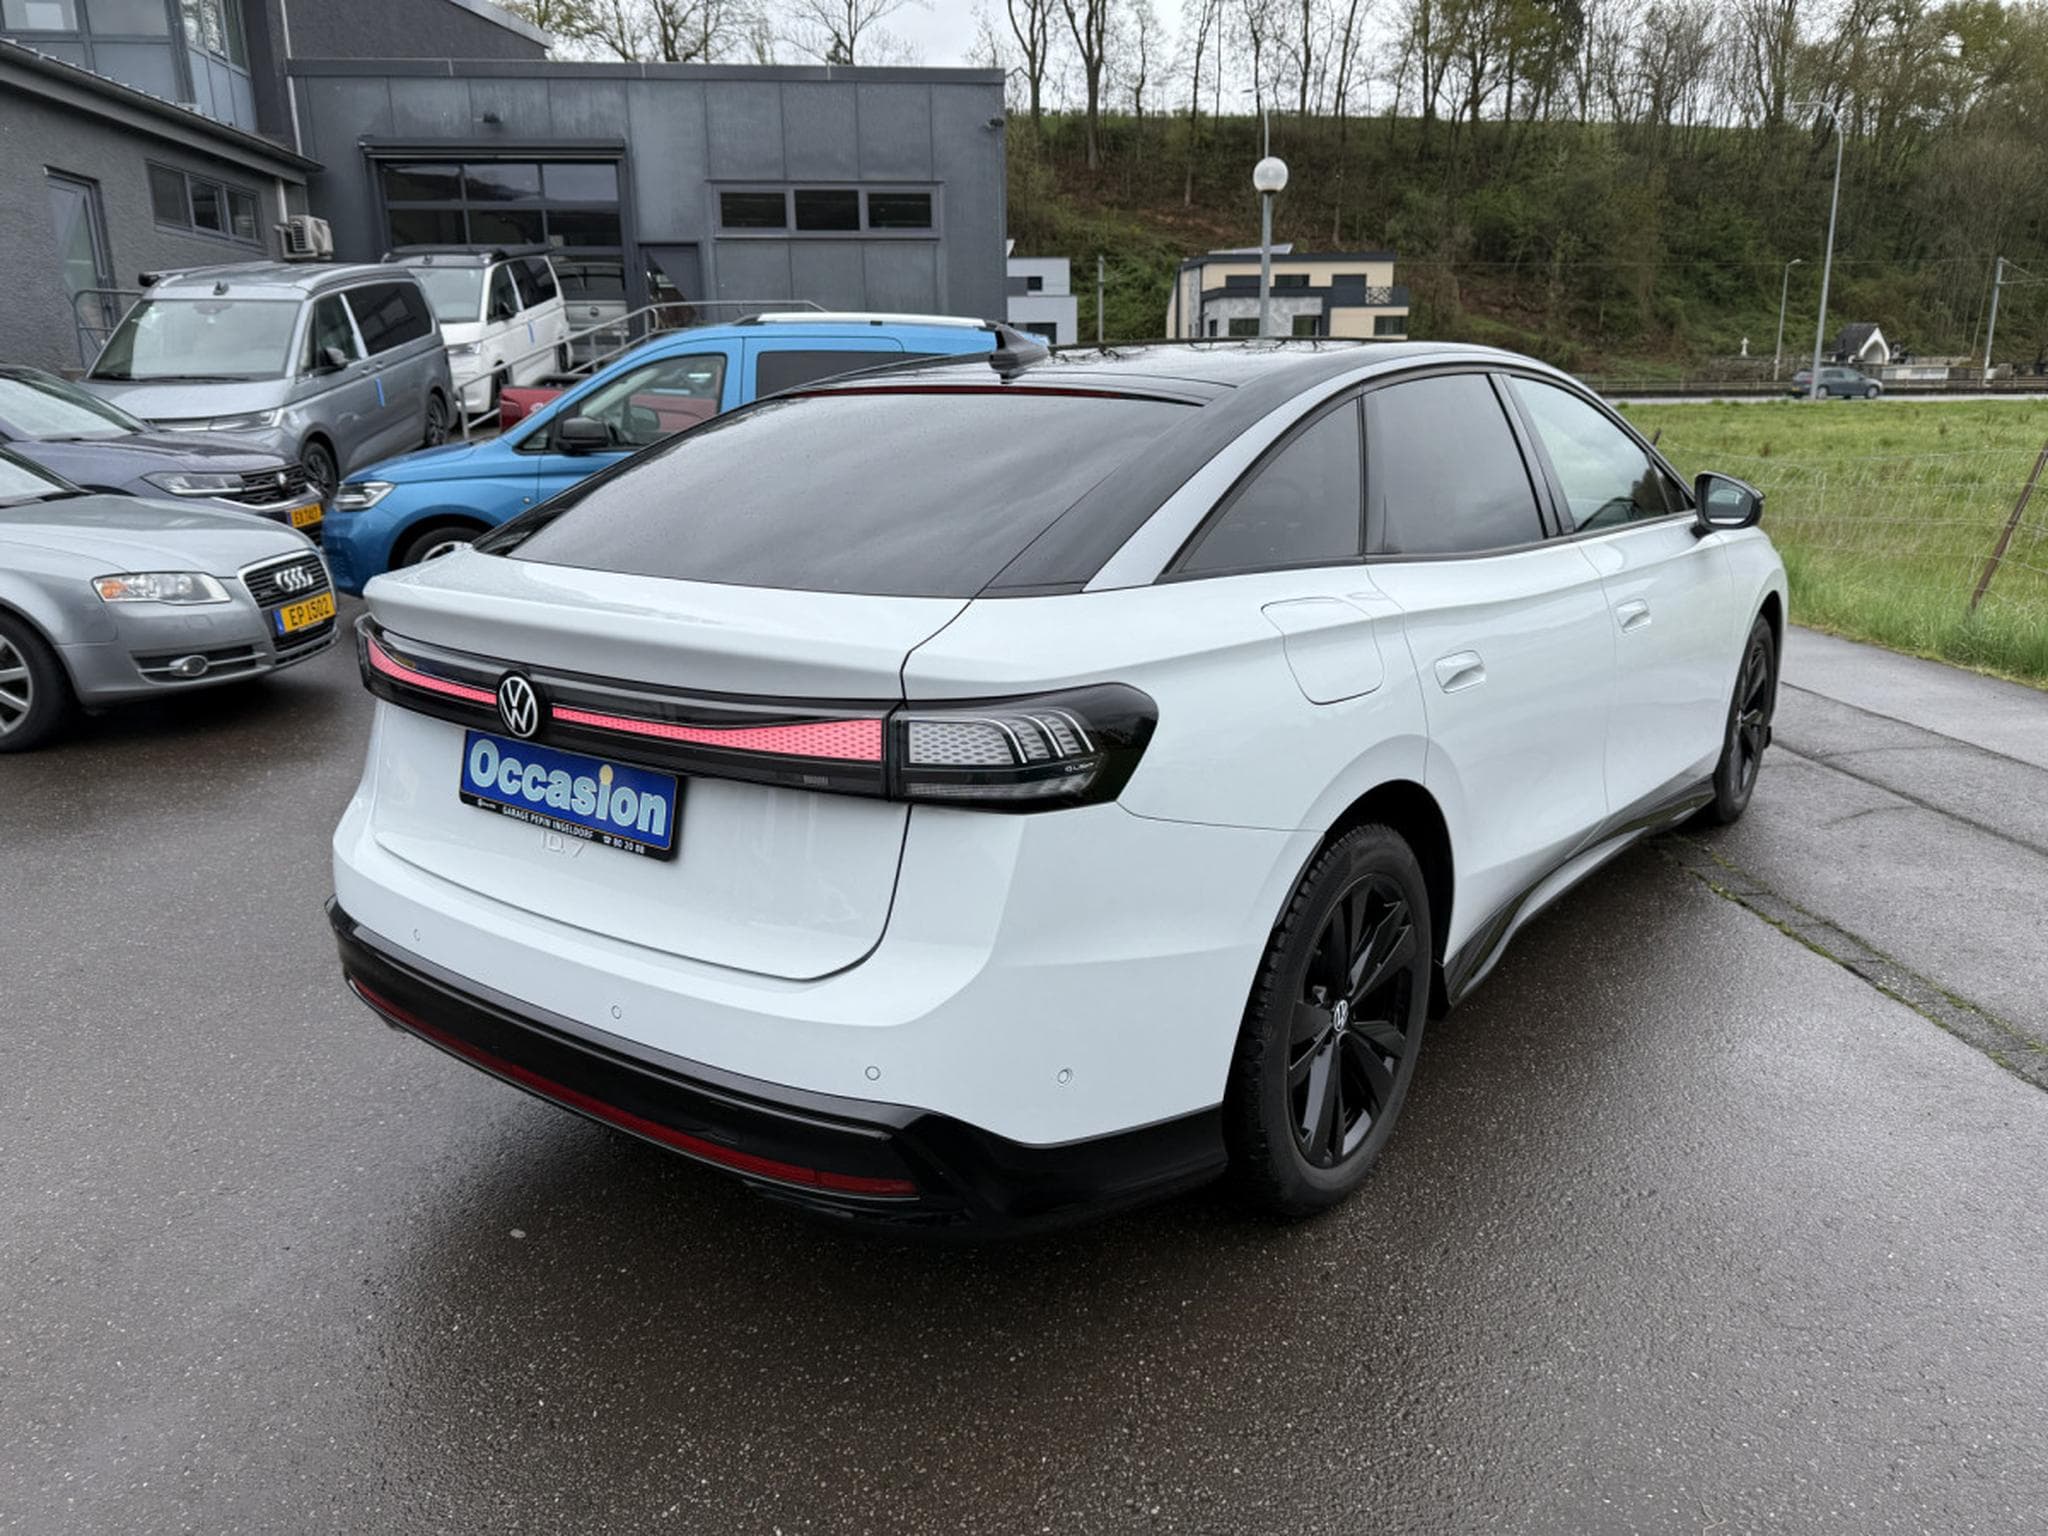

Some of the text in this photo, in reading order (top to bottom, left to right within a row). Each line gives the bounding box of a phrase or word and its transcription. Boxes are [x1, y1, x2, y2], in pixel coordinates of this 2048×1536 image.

[470, 739, 666, 836] Occasion
[502, 806, 529, 822] GARAGE
[530, 814, 551, 827] PEPIN
[552, 820, 594, 839] INGELDORF
